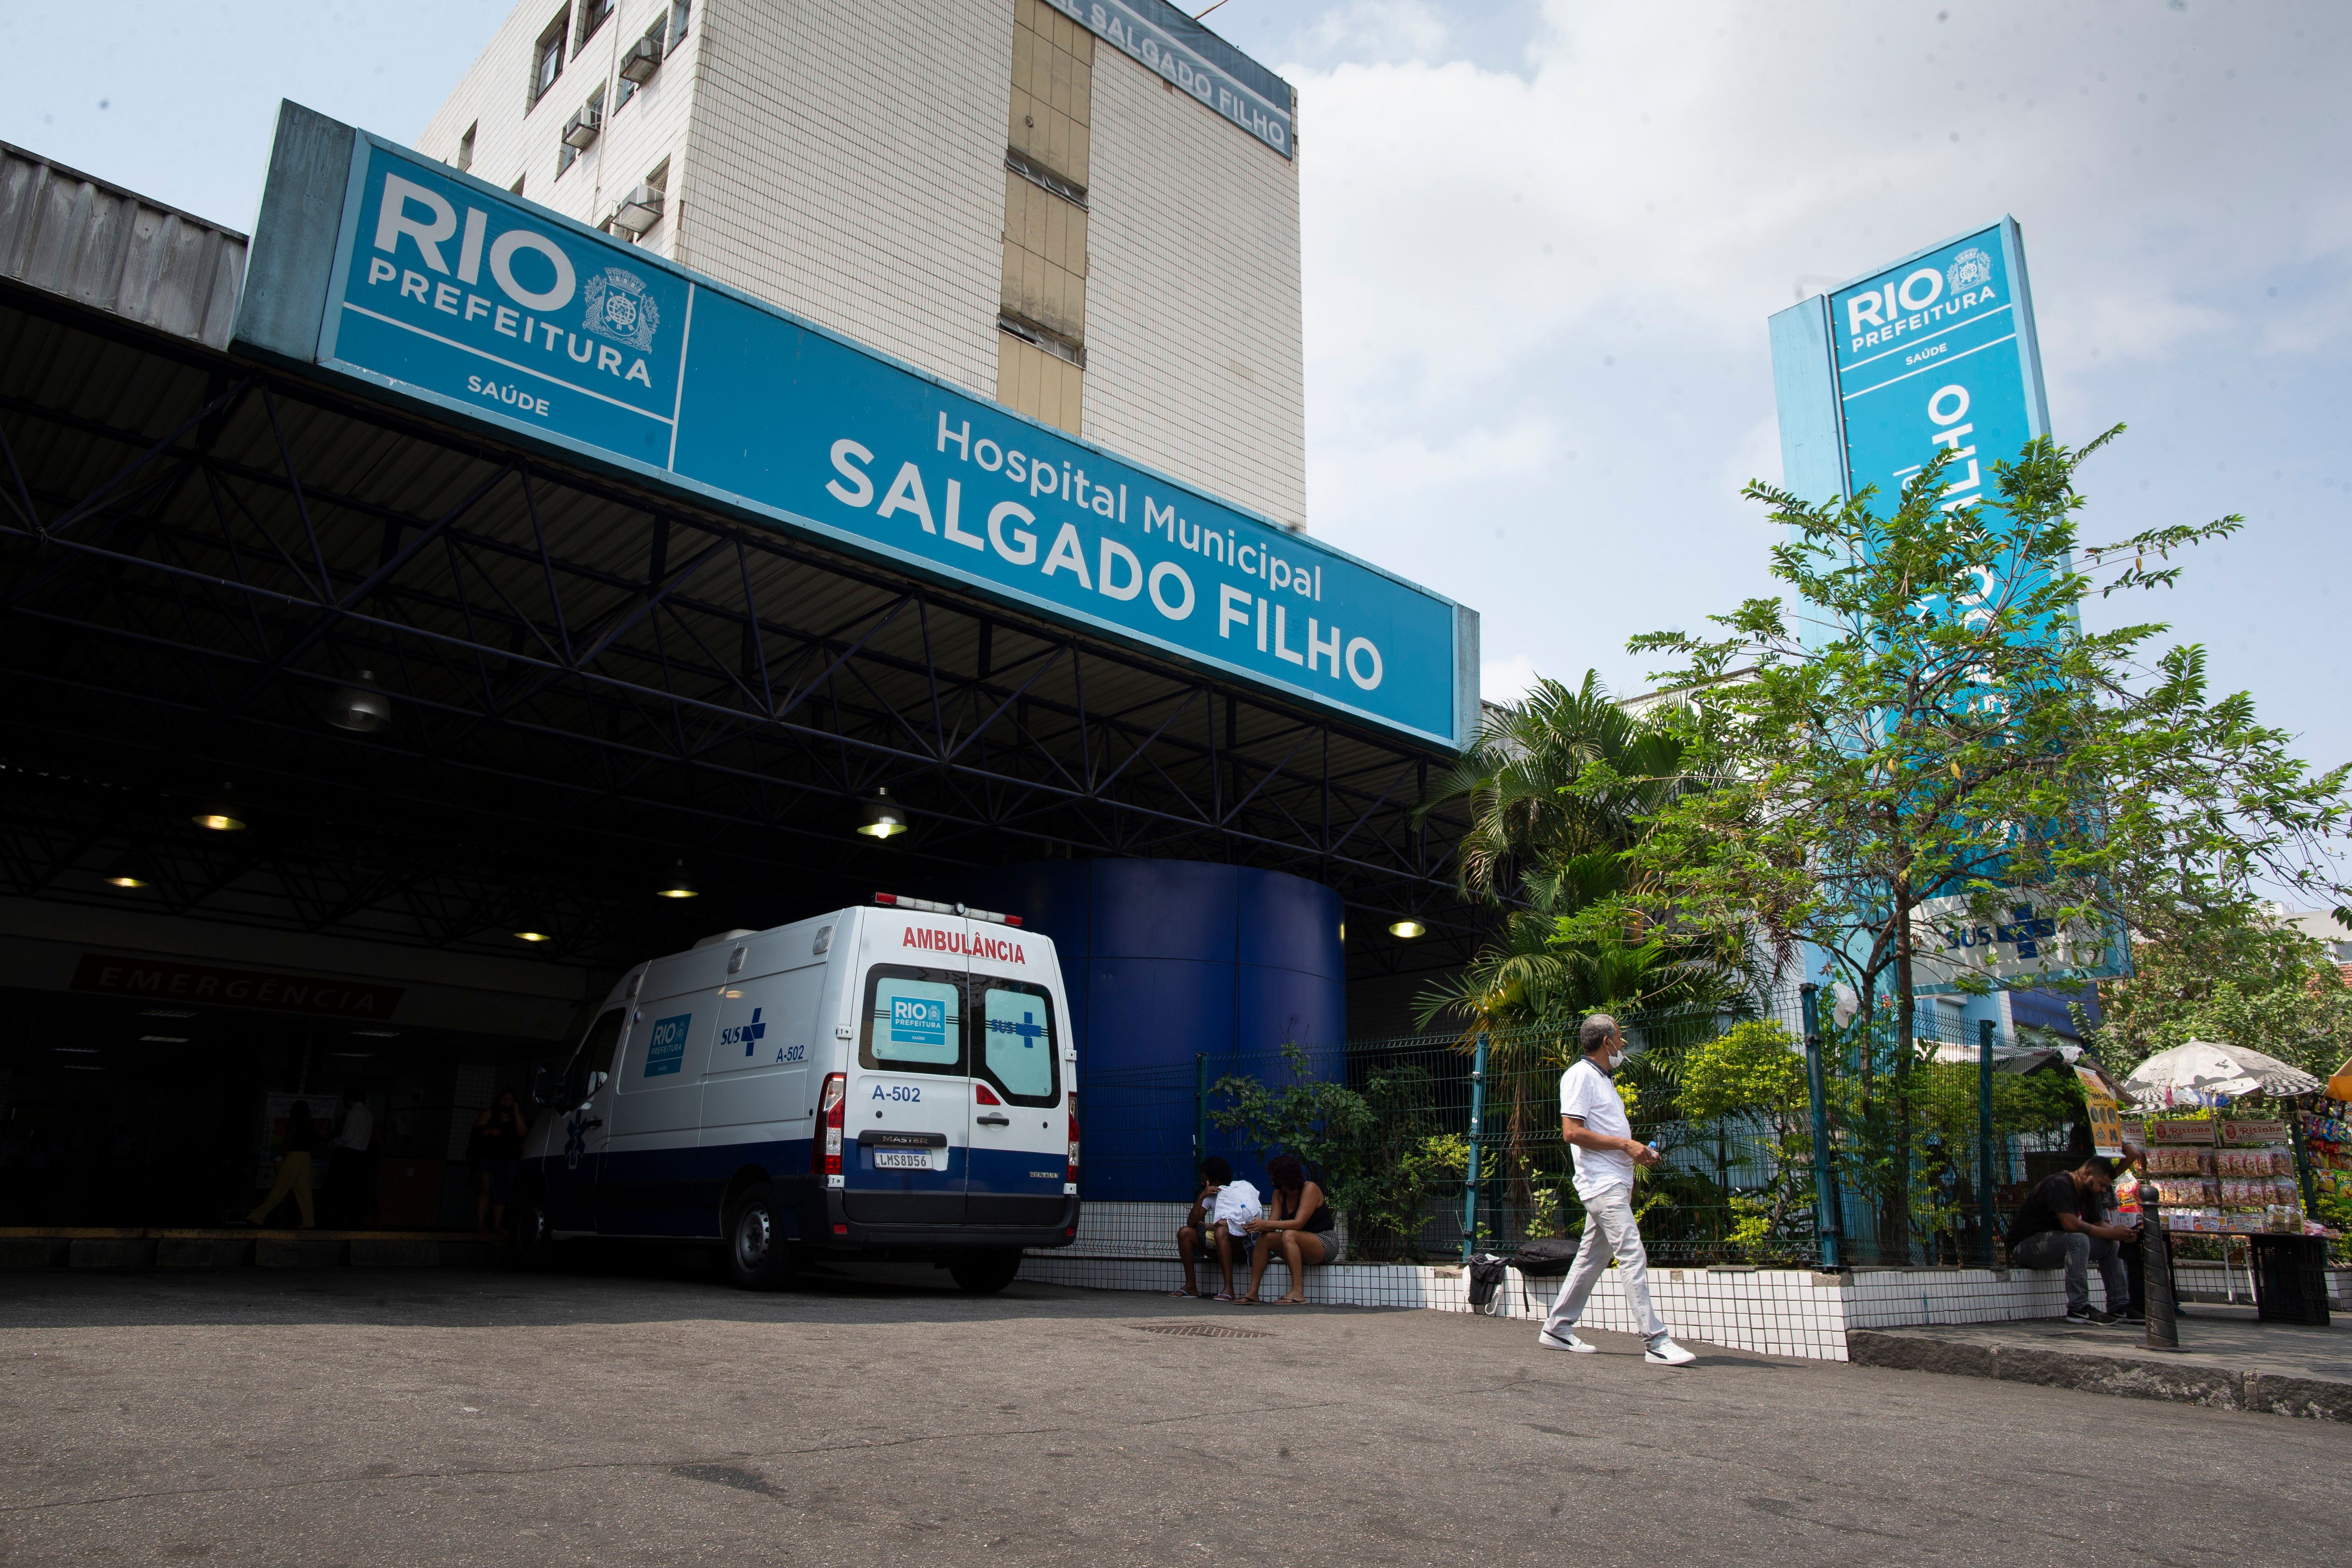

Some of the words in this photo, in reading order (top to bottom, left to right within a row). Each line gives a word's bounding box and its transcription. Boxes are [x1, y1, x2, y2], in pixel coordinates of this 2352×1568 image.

[1090, 4, 1211, 97] SALGADO
[1220, 89, 1285, 145] FILHO
[373, 172, 577, 311] RIO
[1847, 268, 1943, 336] RIO
[368, 257, 652, 388] PREFEITURA
[1852, 286, 1995, 353] PREFEITURA
[1906, 343, 1947, 365] SAÚDE
[467, 373, 550, 417] SAÚDE
[936, 411, 1127, 524] Hospital
[1143, 495, 1321, 601] Municipal
[825, 438, 1196, 621] SALGADO
[1219, 583, 1384, 691] FILHO
[903, 927, 1025, 965] AMBULÂNCIA
[1946, 926, 1992, 950] SUS
[97, 965, 376, 1014] EMERGÊNCIA
[895, 1001, 926, 1019] RIO
[653, 1023, 676, 1046] RIO
[720, 1026, 741, 1045] SUS
[895, 1019, 941, 1029] PREFEITURA
[991, 1019, 1014, 1034] SUS
[651, 1044, 682, 1055] PREFEITURA
[775, 1044, 804, 1063] A-502
[872, 1084, 921, 1102] A-502
[880, 1154, 926, 1166] LMS8D56
